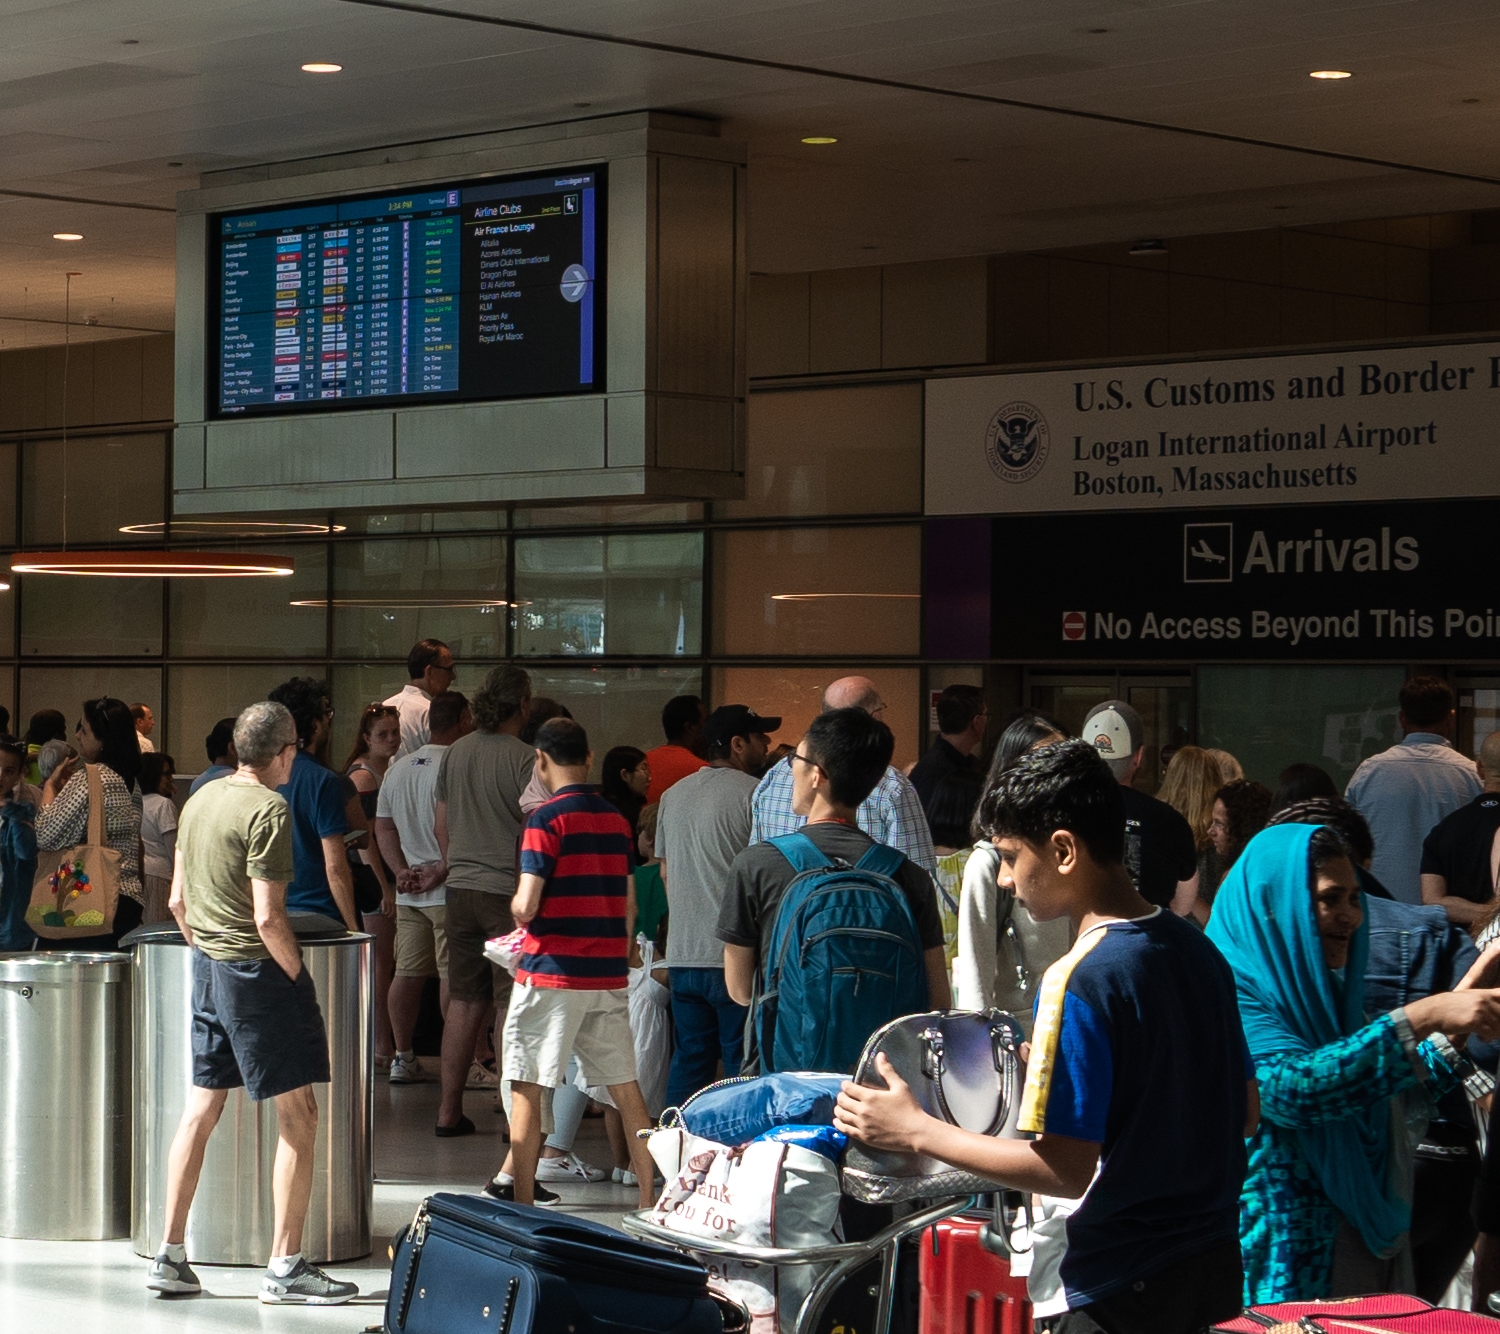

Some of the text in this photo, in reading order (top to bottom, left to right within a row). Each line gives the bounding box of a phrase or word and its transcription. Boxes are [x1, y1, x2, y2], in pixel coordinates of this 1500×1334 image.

[475, 204, 521, 218] Airline Clubs
[474, 222, 535, 236] Air France Lounge
[501, 247, 522, 256] Airlines
[481, 255, 550, 269] Diners Club International
[481, 269, 517, 280] Dragon Pass
[495, 280, 515, 288] Airlines
[480, 290, 521, 300] Hainan Airlines
[480, 303, 492, 311] KLM
[480, 313, 499, 322] Korean
[480, 322, 514, 333] Priority Pass
[479, 334, 495, 344] Royal
[506, 332, 523, 341] Maroc
[1073, 379, 1132, 412] U.S.
[1144, 377, 1275, 409] Customs
[1287, 366, 1345, 400] and
[1358, 360, 1475, 396] Border
[1073, 421, 1437, 467] Logan International Airport
[1073, 463, 1357, 499] Boston, Massachusetts
[1242, 527, 1420, 574] Arrivals
[1094, 612, 1132, 640] No
[1140, 612, 1241, 639] Access
[1251, 610, 1360, 645] Beyond
[1370, 609, 1434, 639] This
[703, 1207, 737, 1234] for
